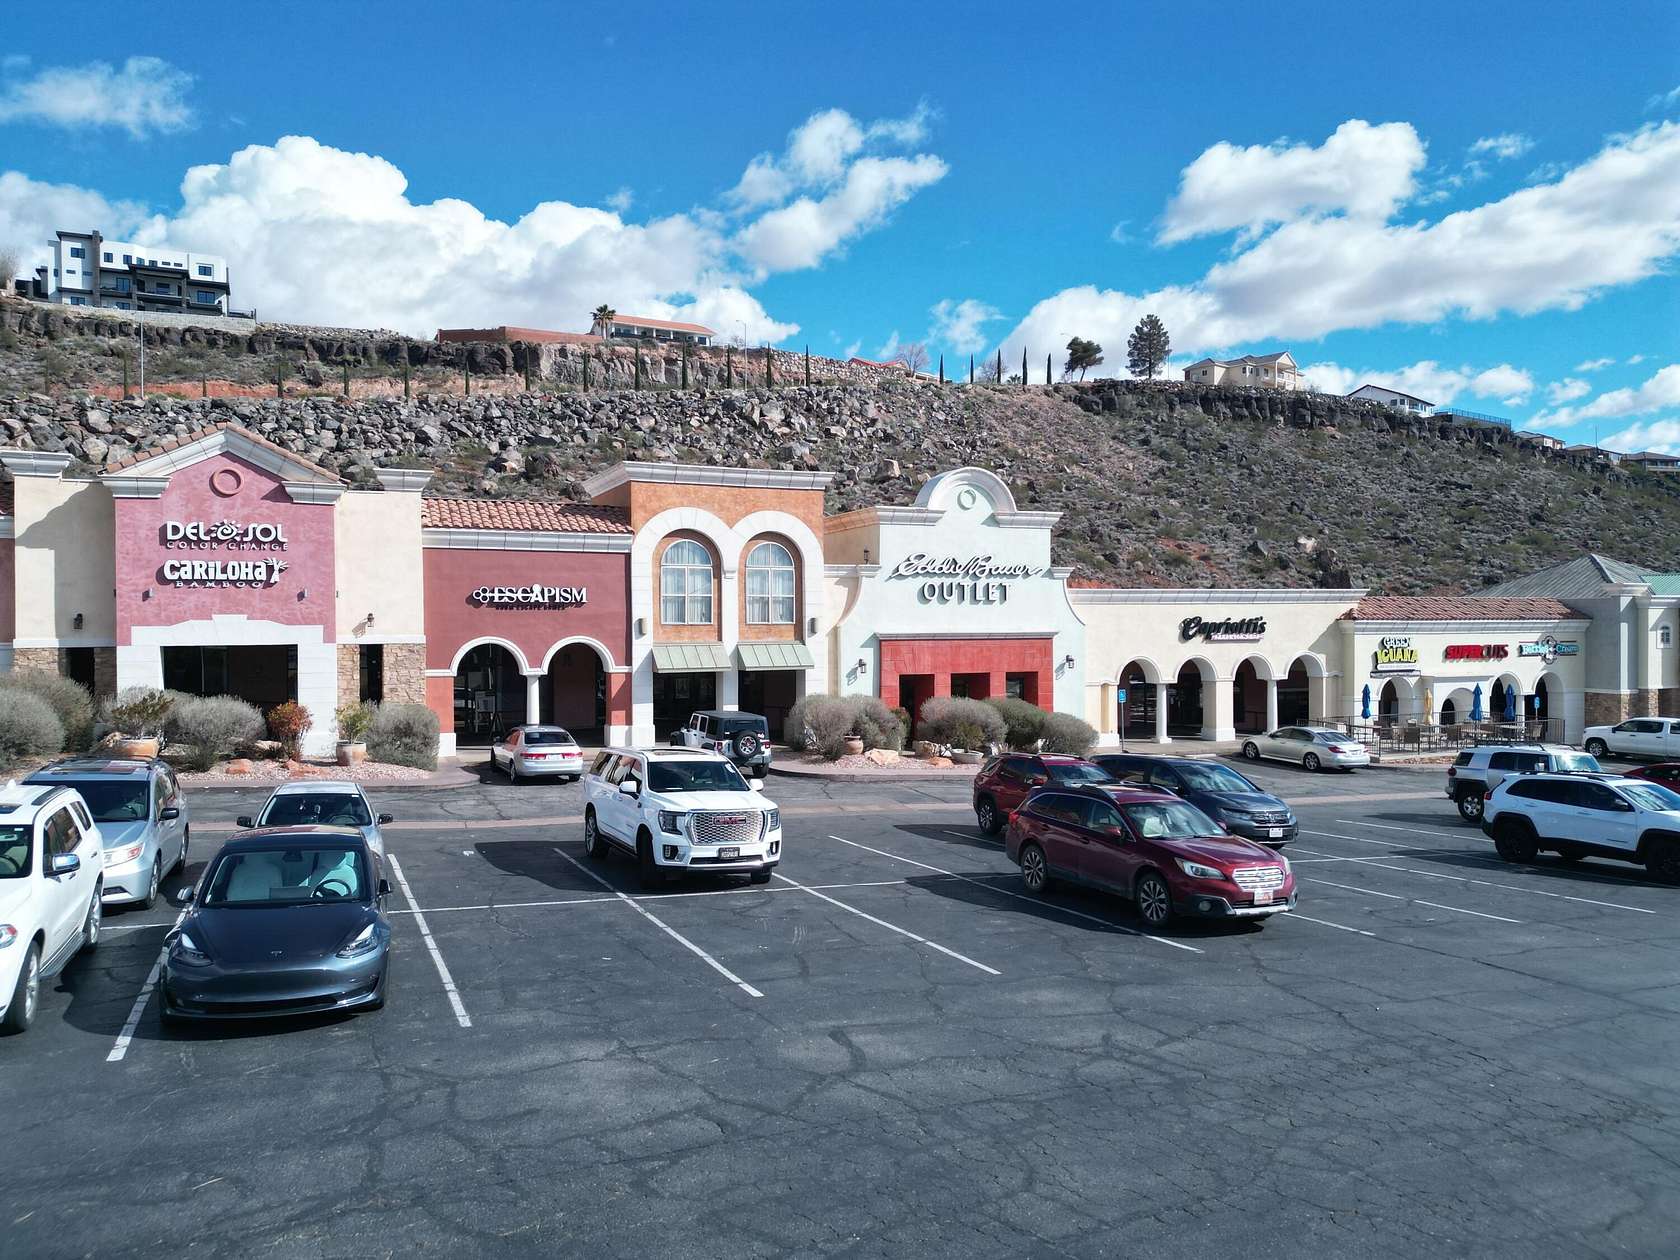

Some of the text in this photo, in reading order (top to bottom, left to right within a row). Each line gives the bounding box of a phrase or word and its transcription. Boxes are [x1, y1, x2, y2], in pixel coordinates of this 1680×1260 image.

[166, 520, 288, 542] DEL SOL
[166, 541, 288, 551] COLOR CHANGE
[493, 584, 588, 603] ESCAPISM
[923, 581, 1010, 601] OUTLET
[1377, 648, 1417, 664] IGUANA
[1445, 644, 1509, 659] SUPERCUTS
